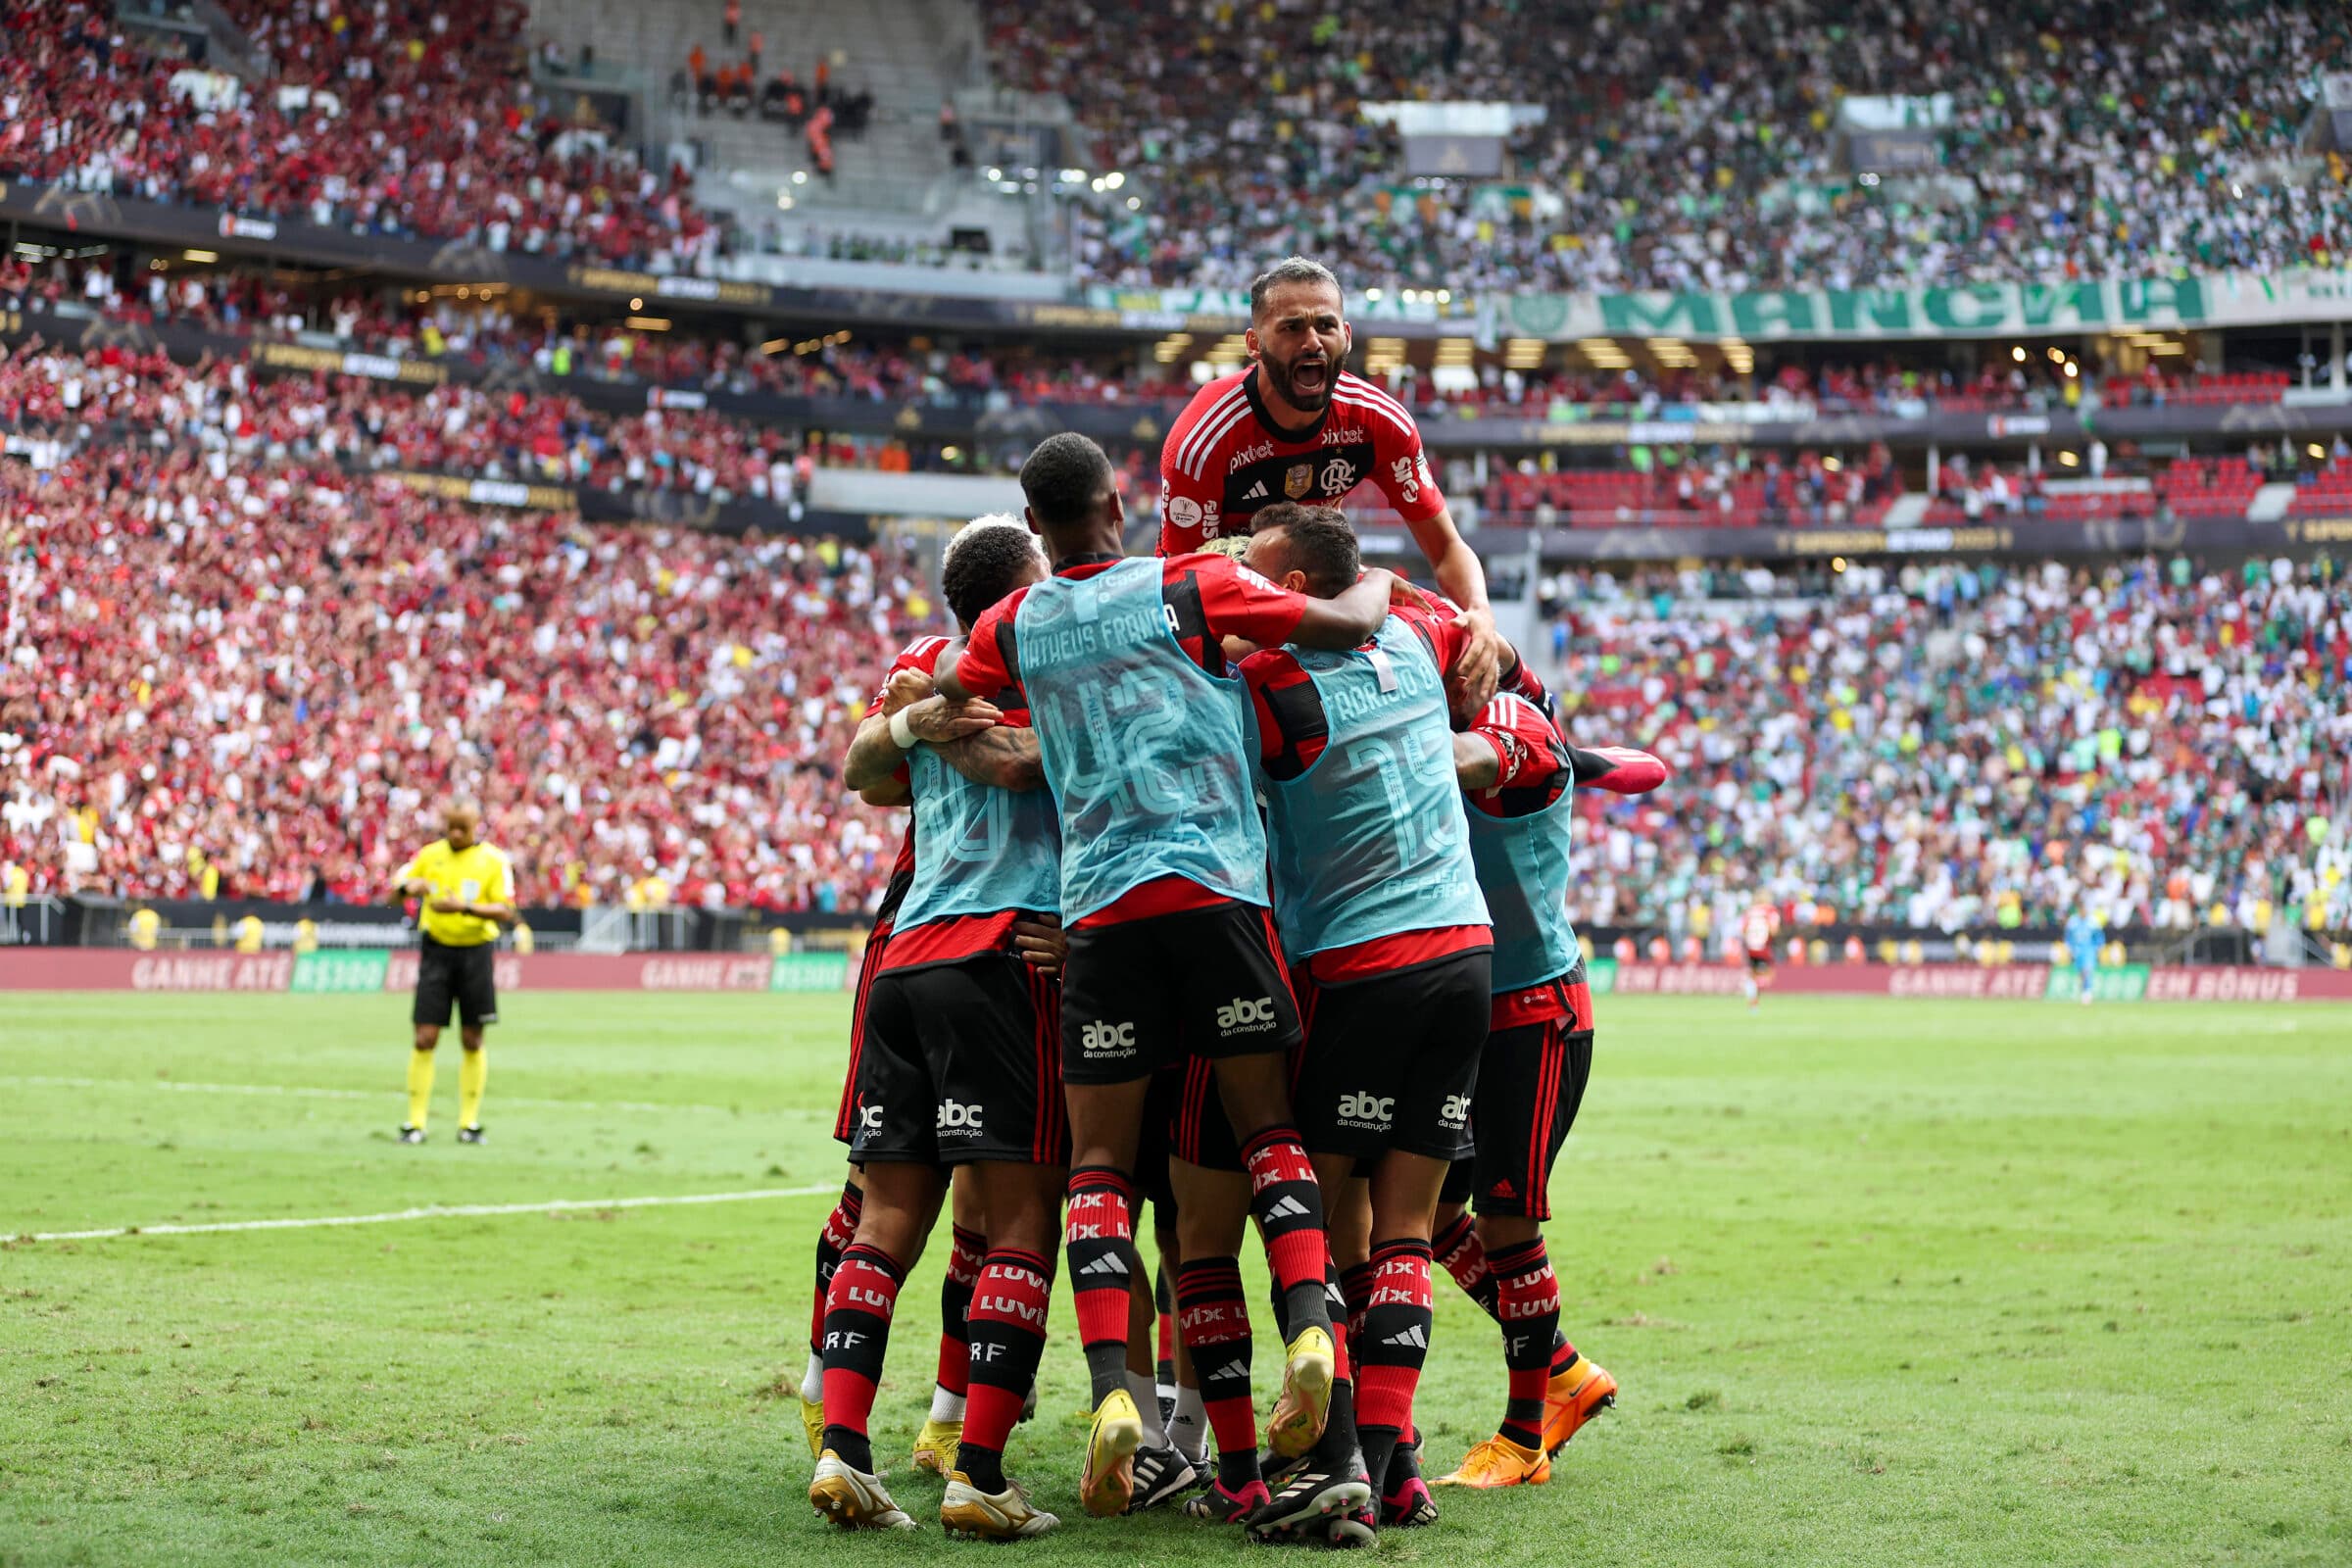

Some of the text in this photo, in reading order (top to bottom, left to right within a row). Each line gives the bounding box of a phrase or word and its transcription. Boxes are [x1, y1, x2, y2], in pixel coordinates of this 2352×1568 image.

[1230, 439, 1275, 474] pixbet
[131, 956, 232, 990] GANHE
[236, 952, 291, 990] ATÉ
[2146, 971, 2190, 1000] EM
[2193, 965, 2299, 1001] BÔNUS
[1216, 996, 1275, 1028] abc
[1082, 1019, 1135, 1050] abc
[1220, 1020, 1277, 1037] da construção
[1083, 1048, 1137, 1059] da construção
[1338, 1090, 1396, 1121] abc
[941, 1128, 983, 1138] construção
[1348, 1119, 1392, 1132] construção
